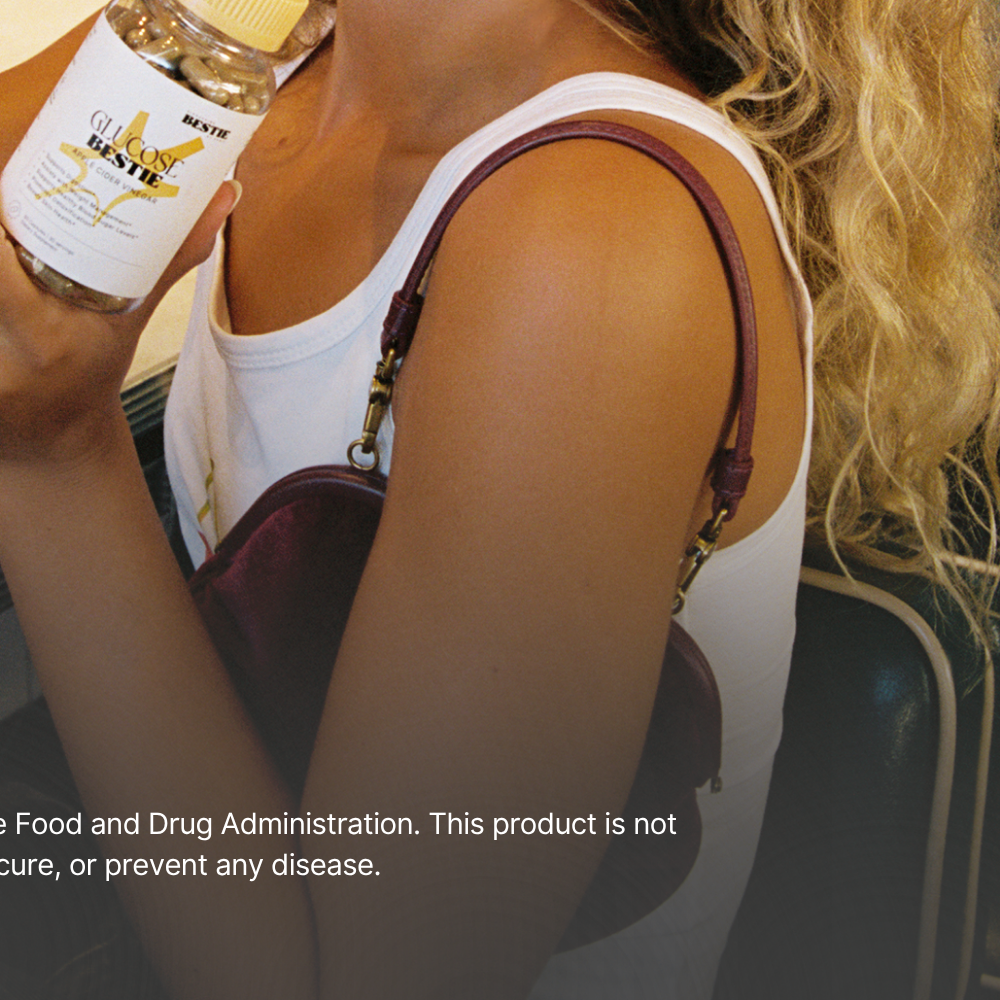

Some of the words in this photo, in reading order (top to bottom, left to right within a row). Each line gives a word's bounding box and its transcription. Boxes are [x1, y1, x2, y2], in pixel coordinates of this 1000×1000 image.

[90, 110, 185, 178] GLUCOSE
[182, 113, 231, 140] BESTIE
[72, 148, 95, 169] APPLE
[96, 166, 121, 186] CIDER
[122, 182, 158, 204] VINEGAR
[87, 133, 164, 189] BESTIE
